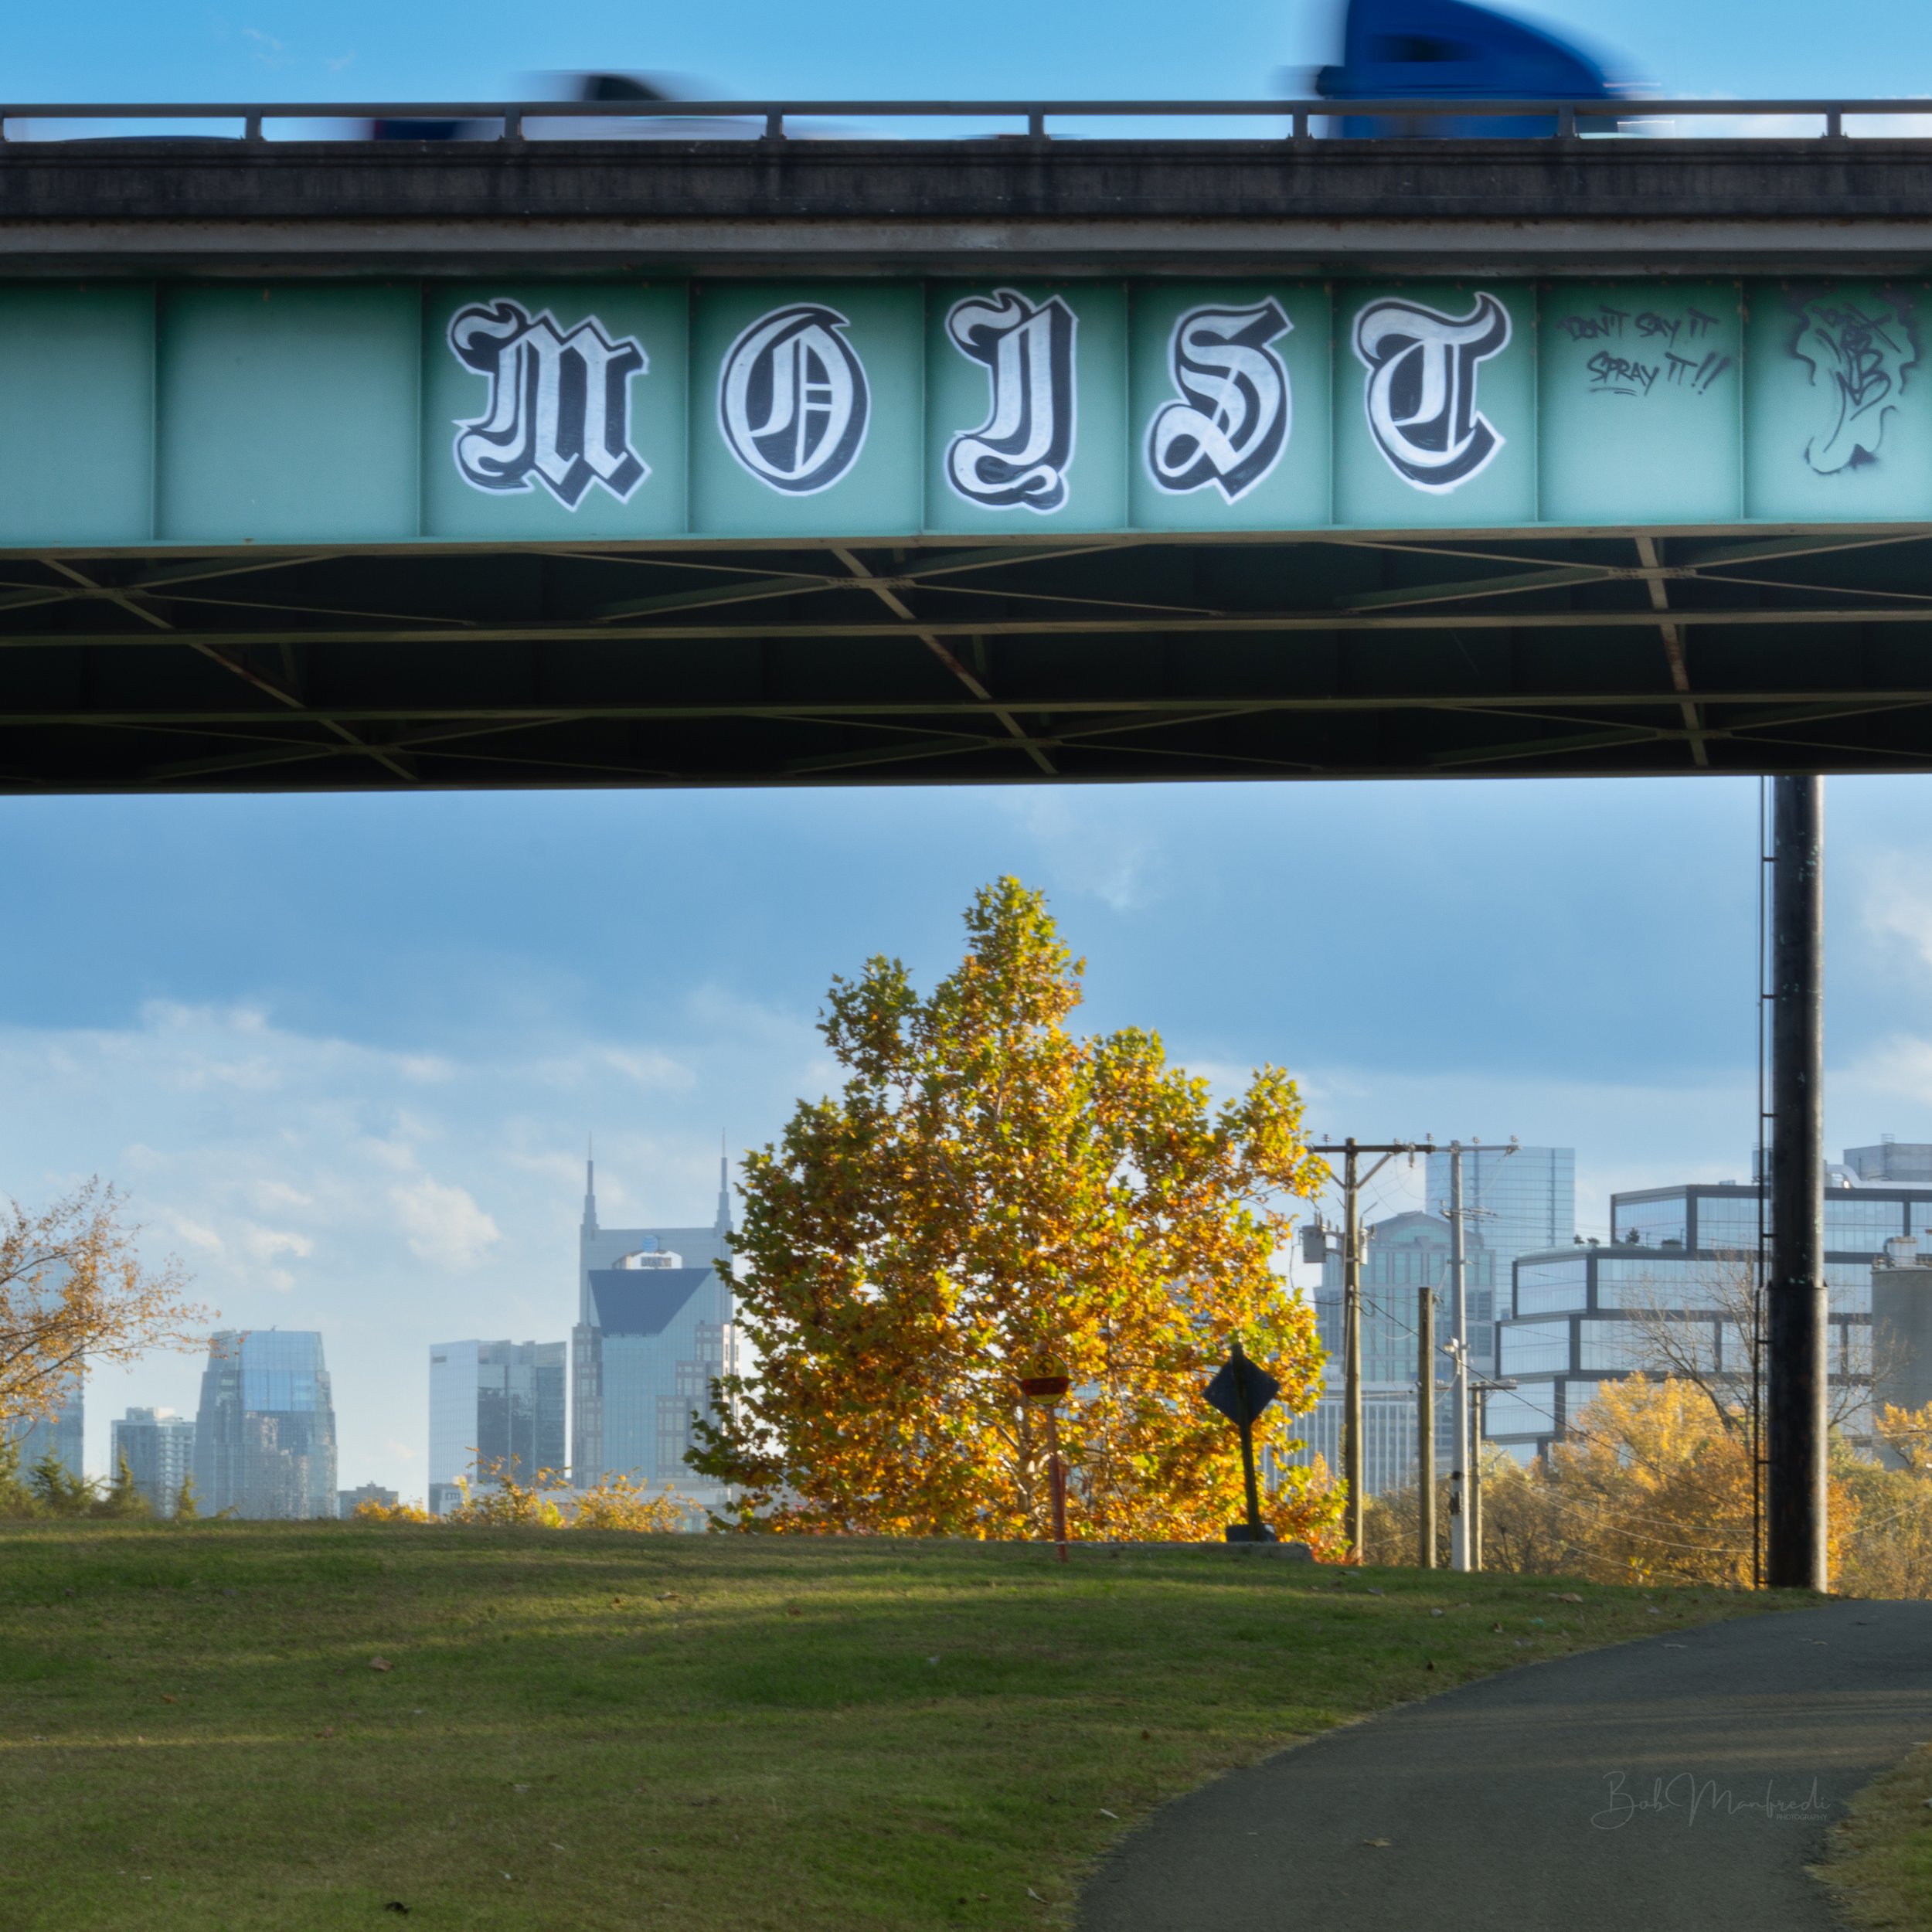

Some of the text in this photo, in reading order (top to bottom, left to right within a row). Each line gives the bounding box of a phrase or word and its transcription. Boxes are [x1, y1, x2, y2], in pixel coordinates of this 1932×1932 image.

[1560, 306, 1720, 348] DON'T SAY IT
[1587, 350, 1660, 396] SPRAY
[446, 287, 1513, 515] MOIST
